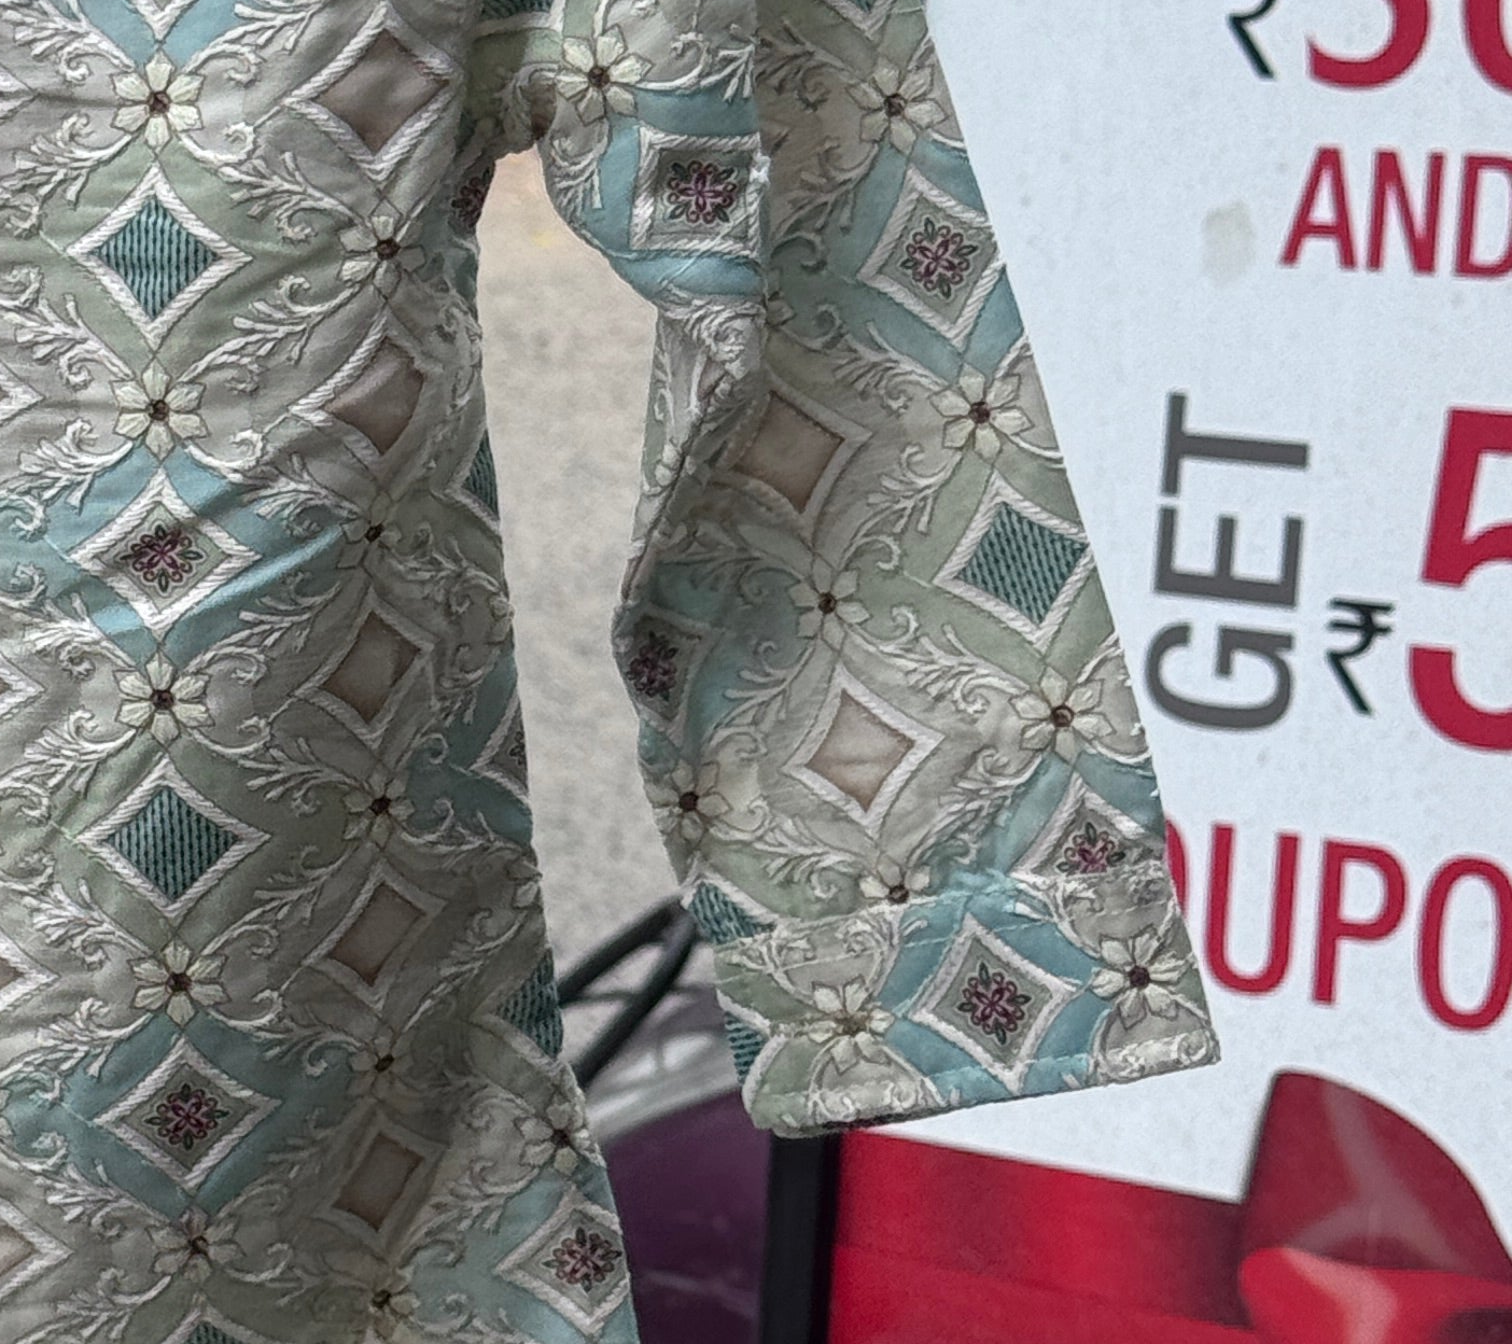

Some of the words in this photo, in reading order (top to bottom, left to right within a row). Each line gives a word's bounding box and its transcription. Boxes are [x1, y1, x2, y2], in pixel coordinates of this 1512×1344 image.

[1279, 147, 1512, 279] AND
[1144, 392, 1310, 732] GET
[1165, 819, 1512, 1030] UPO
